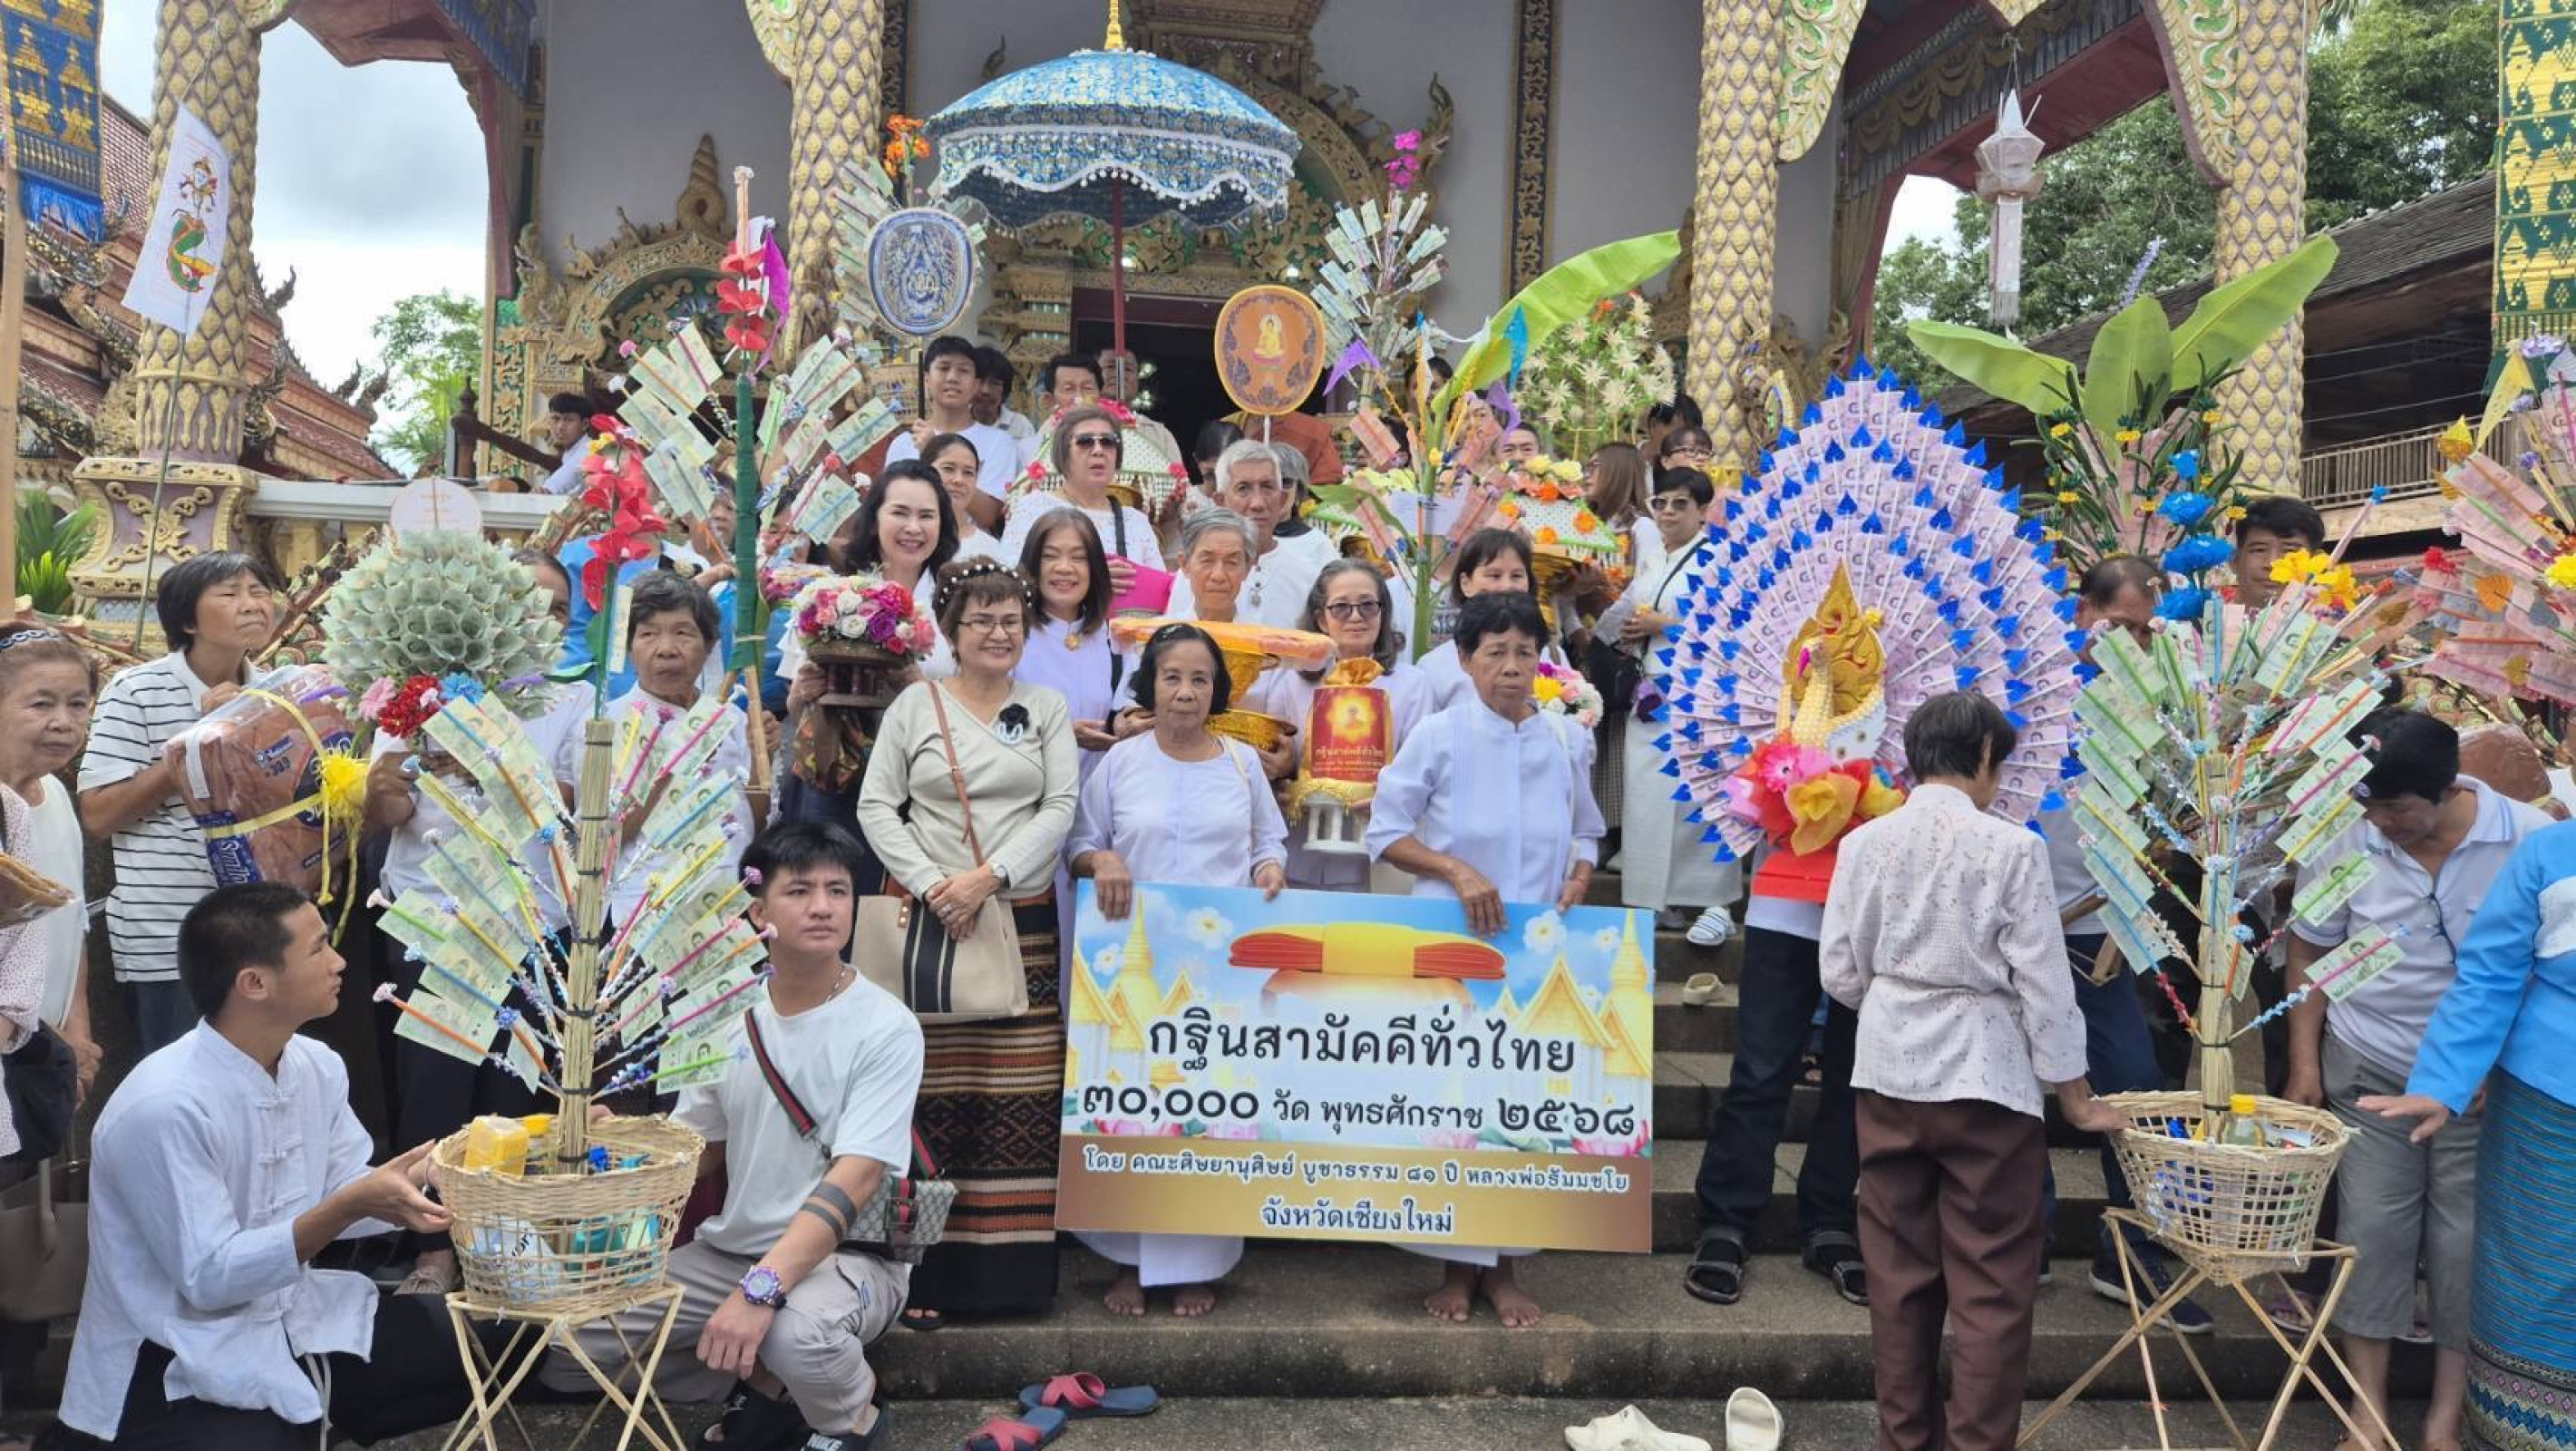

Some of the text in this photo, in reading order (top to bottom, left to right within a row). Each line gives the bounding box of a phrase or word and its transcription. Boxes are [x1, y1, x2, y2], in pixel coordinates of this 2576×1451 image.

[1149, 1003, 1575, 1072] กฐินสามัคคีทั่วไทย
[1084, 1086, 1635, 1135] ๓๐,๐๐๐ วัด พุทธศักราช ๒๕๖๘
[1085, 1146, 1629, 1190] โดย คณะศิษยานุศิษย์ บูชาธรรม ๘๑ ปี หลวงพ่อธัมมชโย
[1262, 1196, 1453, 1232] จังหวัดเชียงใหม่
